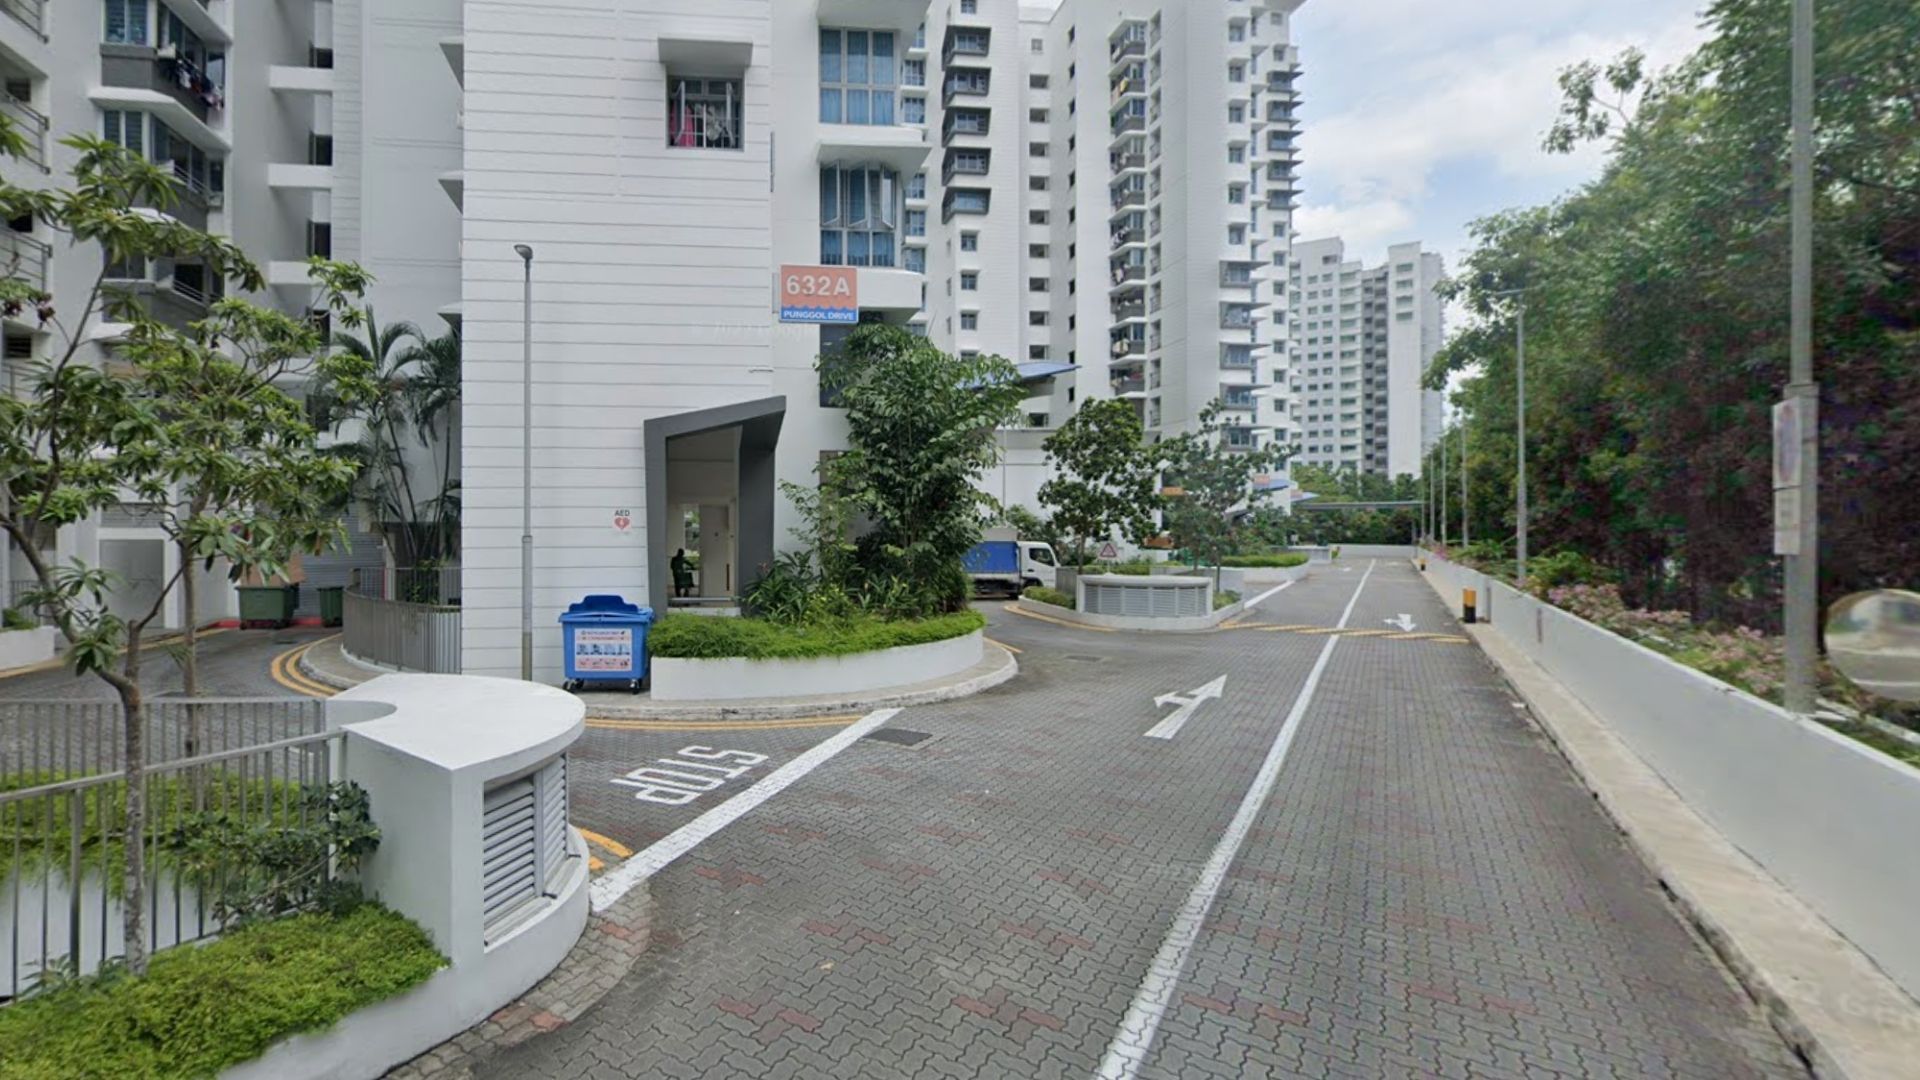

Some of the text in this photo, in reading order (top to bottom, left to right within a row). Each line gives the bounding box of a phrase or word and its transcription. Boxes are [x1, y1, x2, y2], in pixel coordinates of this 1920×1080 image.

[786, 275, 850, 296] 632A
[784, 310, 854, 320] PUNGGOL DRIVE
[614, 509, 630, 517] AED
[610, 745, 769, 805] STOP
